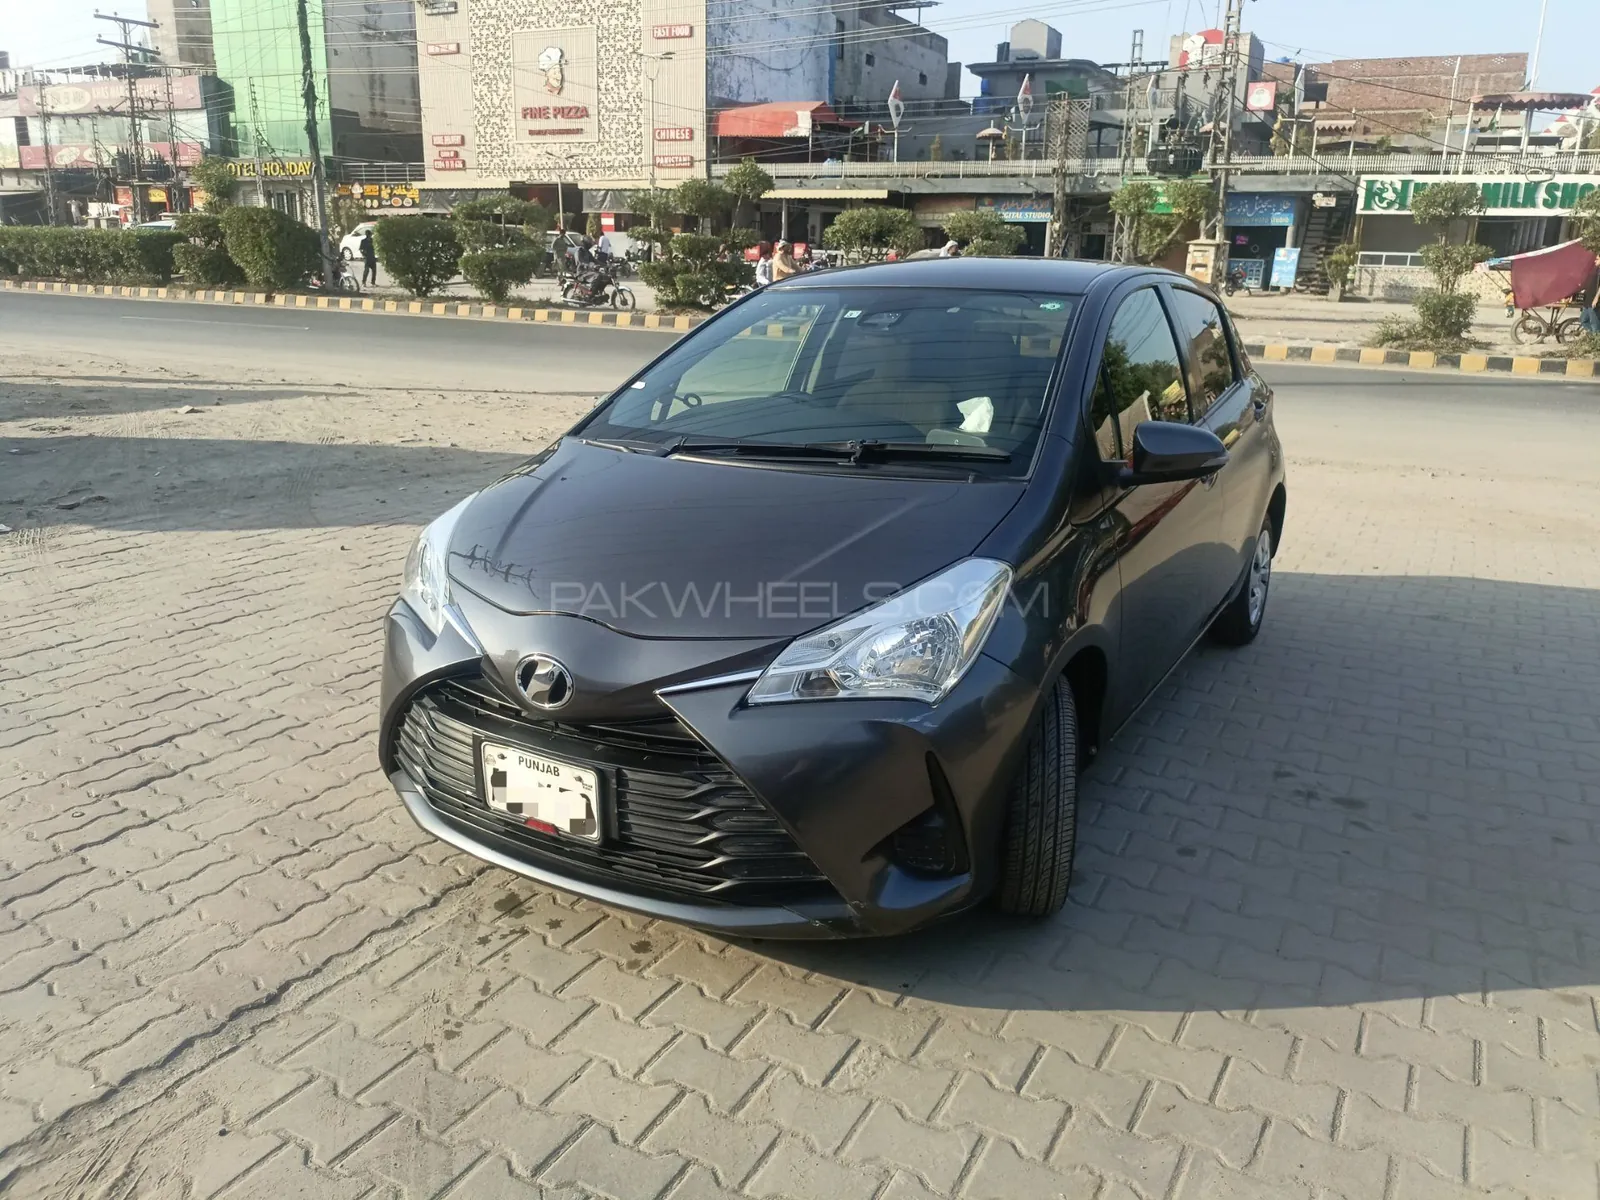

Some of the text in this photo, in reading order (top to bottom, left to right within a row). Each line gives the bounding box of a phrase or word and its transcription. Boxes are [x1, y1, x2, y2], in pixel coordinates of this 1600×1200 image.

[654, 25, 690, 37] FAST FOOD
[521, 105, 589, 119] FINE PIZZA
[655, 128, 690, 139] CHINESE
[225, 161, 312, 177] OTEL HOLIDAY
[1482, 182, 1539, 208] MILK
[1542, 182, 1600, 209] SHO
[1023, 211, 1051, 219] STUDIO
[518, 755, 560, 777] PUNJAB
